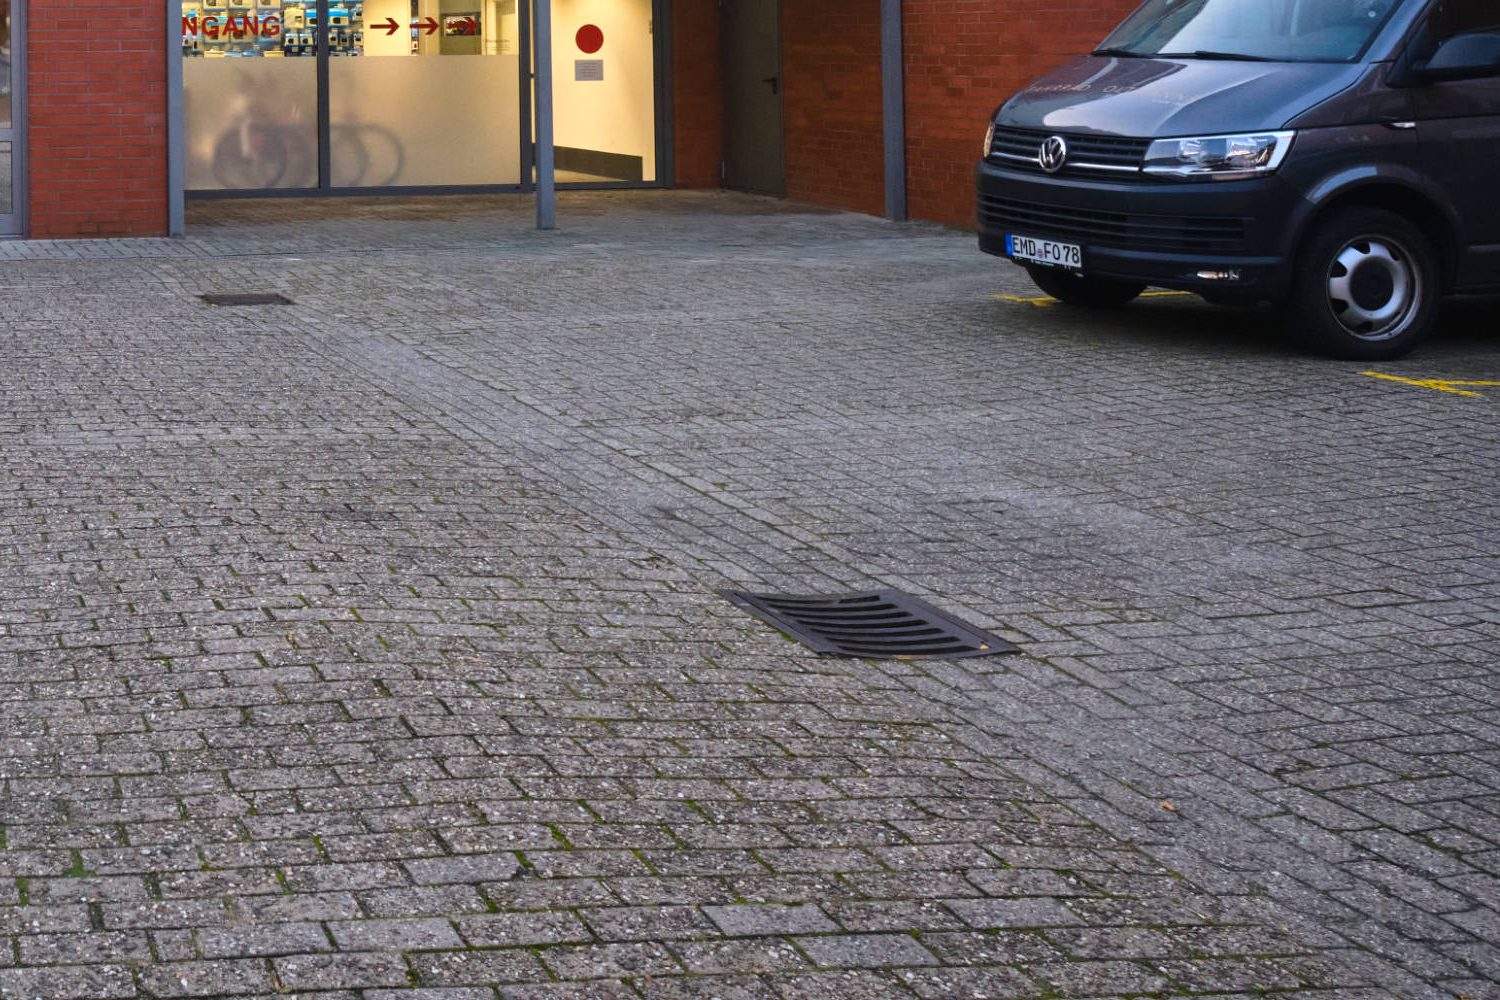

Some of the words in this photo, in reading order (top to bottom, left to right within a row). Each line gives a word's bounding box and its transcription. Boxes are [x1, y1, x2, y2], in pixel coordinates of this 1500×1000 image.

[181, 16, 280, 36] NGANG
[1012, 236, 1036, 257] EMD
[1063, 245, 1080, 264] 78
